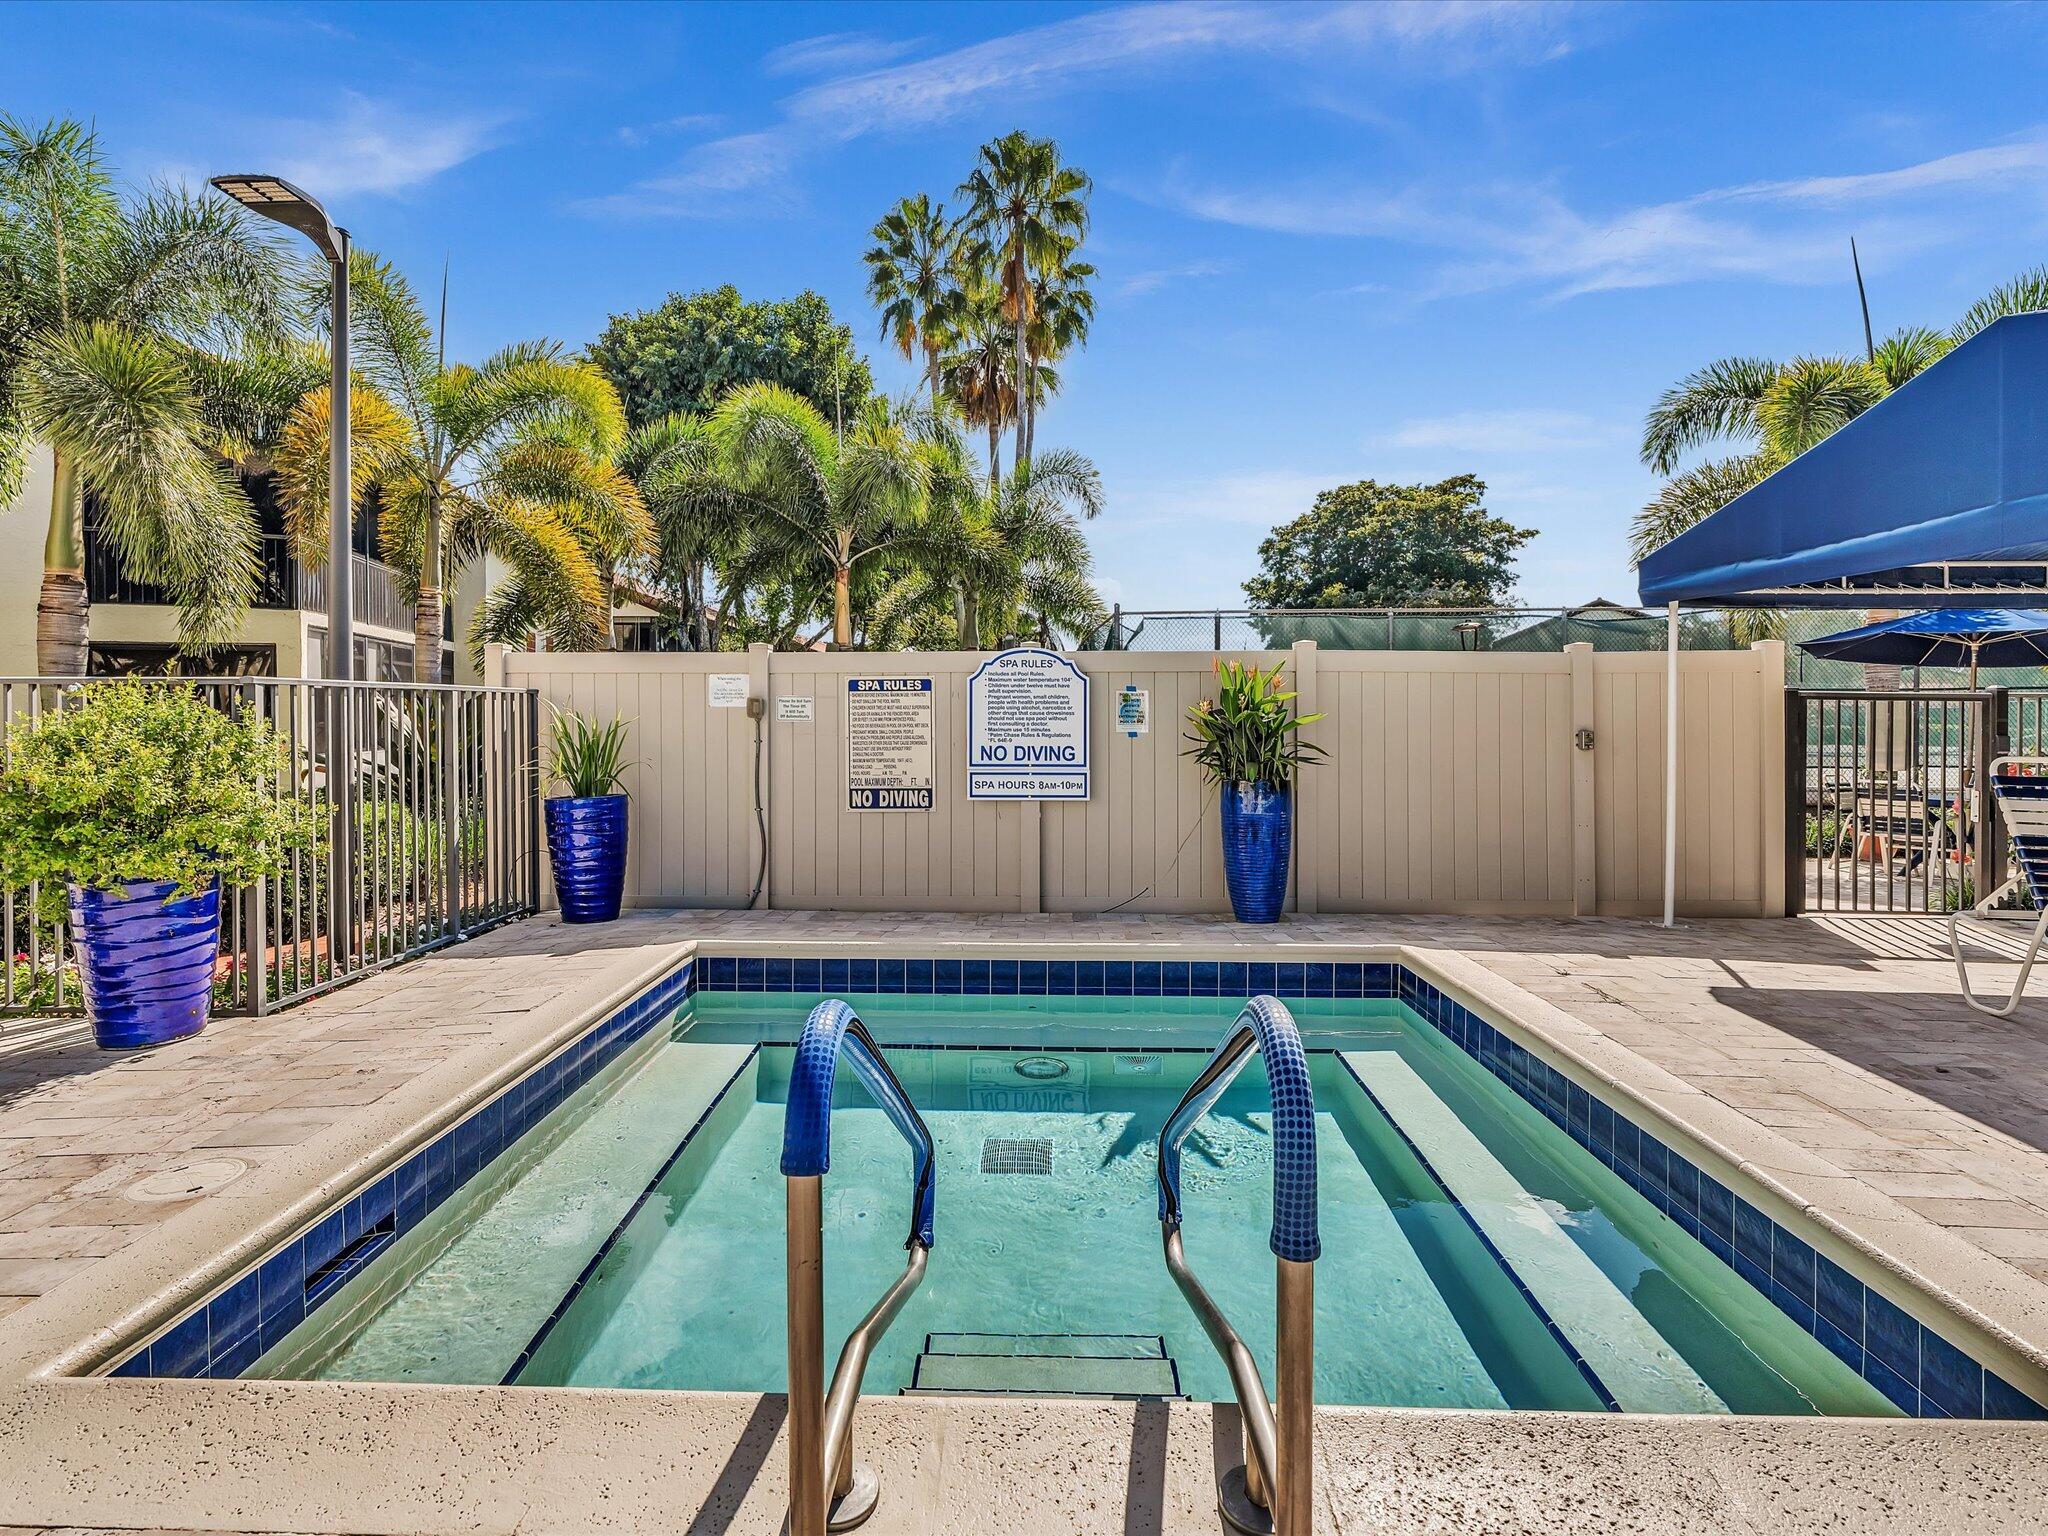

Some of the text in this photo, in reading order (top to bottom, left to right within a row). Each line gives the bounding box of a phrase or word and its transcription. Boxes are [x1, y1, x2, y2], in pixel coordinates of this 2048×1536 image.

[1000, 660, 1018, 668] SPA
[857, 680, 922, 690] SPA RULES
[981, 746, 1076, 761] NO DIVING
[852, 778, 864, 786] POOL
[864, 778, 886, 786] MAXIMUM
[974, 781, 994, 789] SPA
[998, 781, 1035, 789] HOURS
[852, 790, 929, 807] NO DIVING
